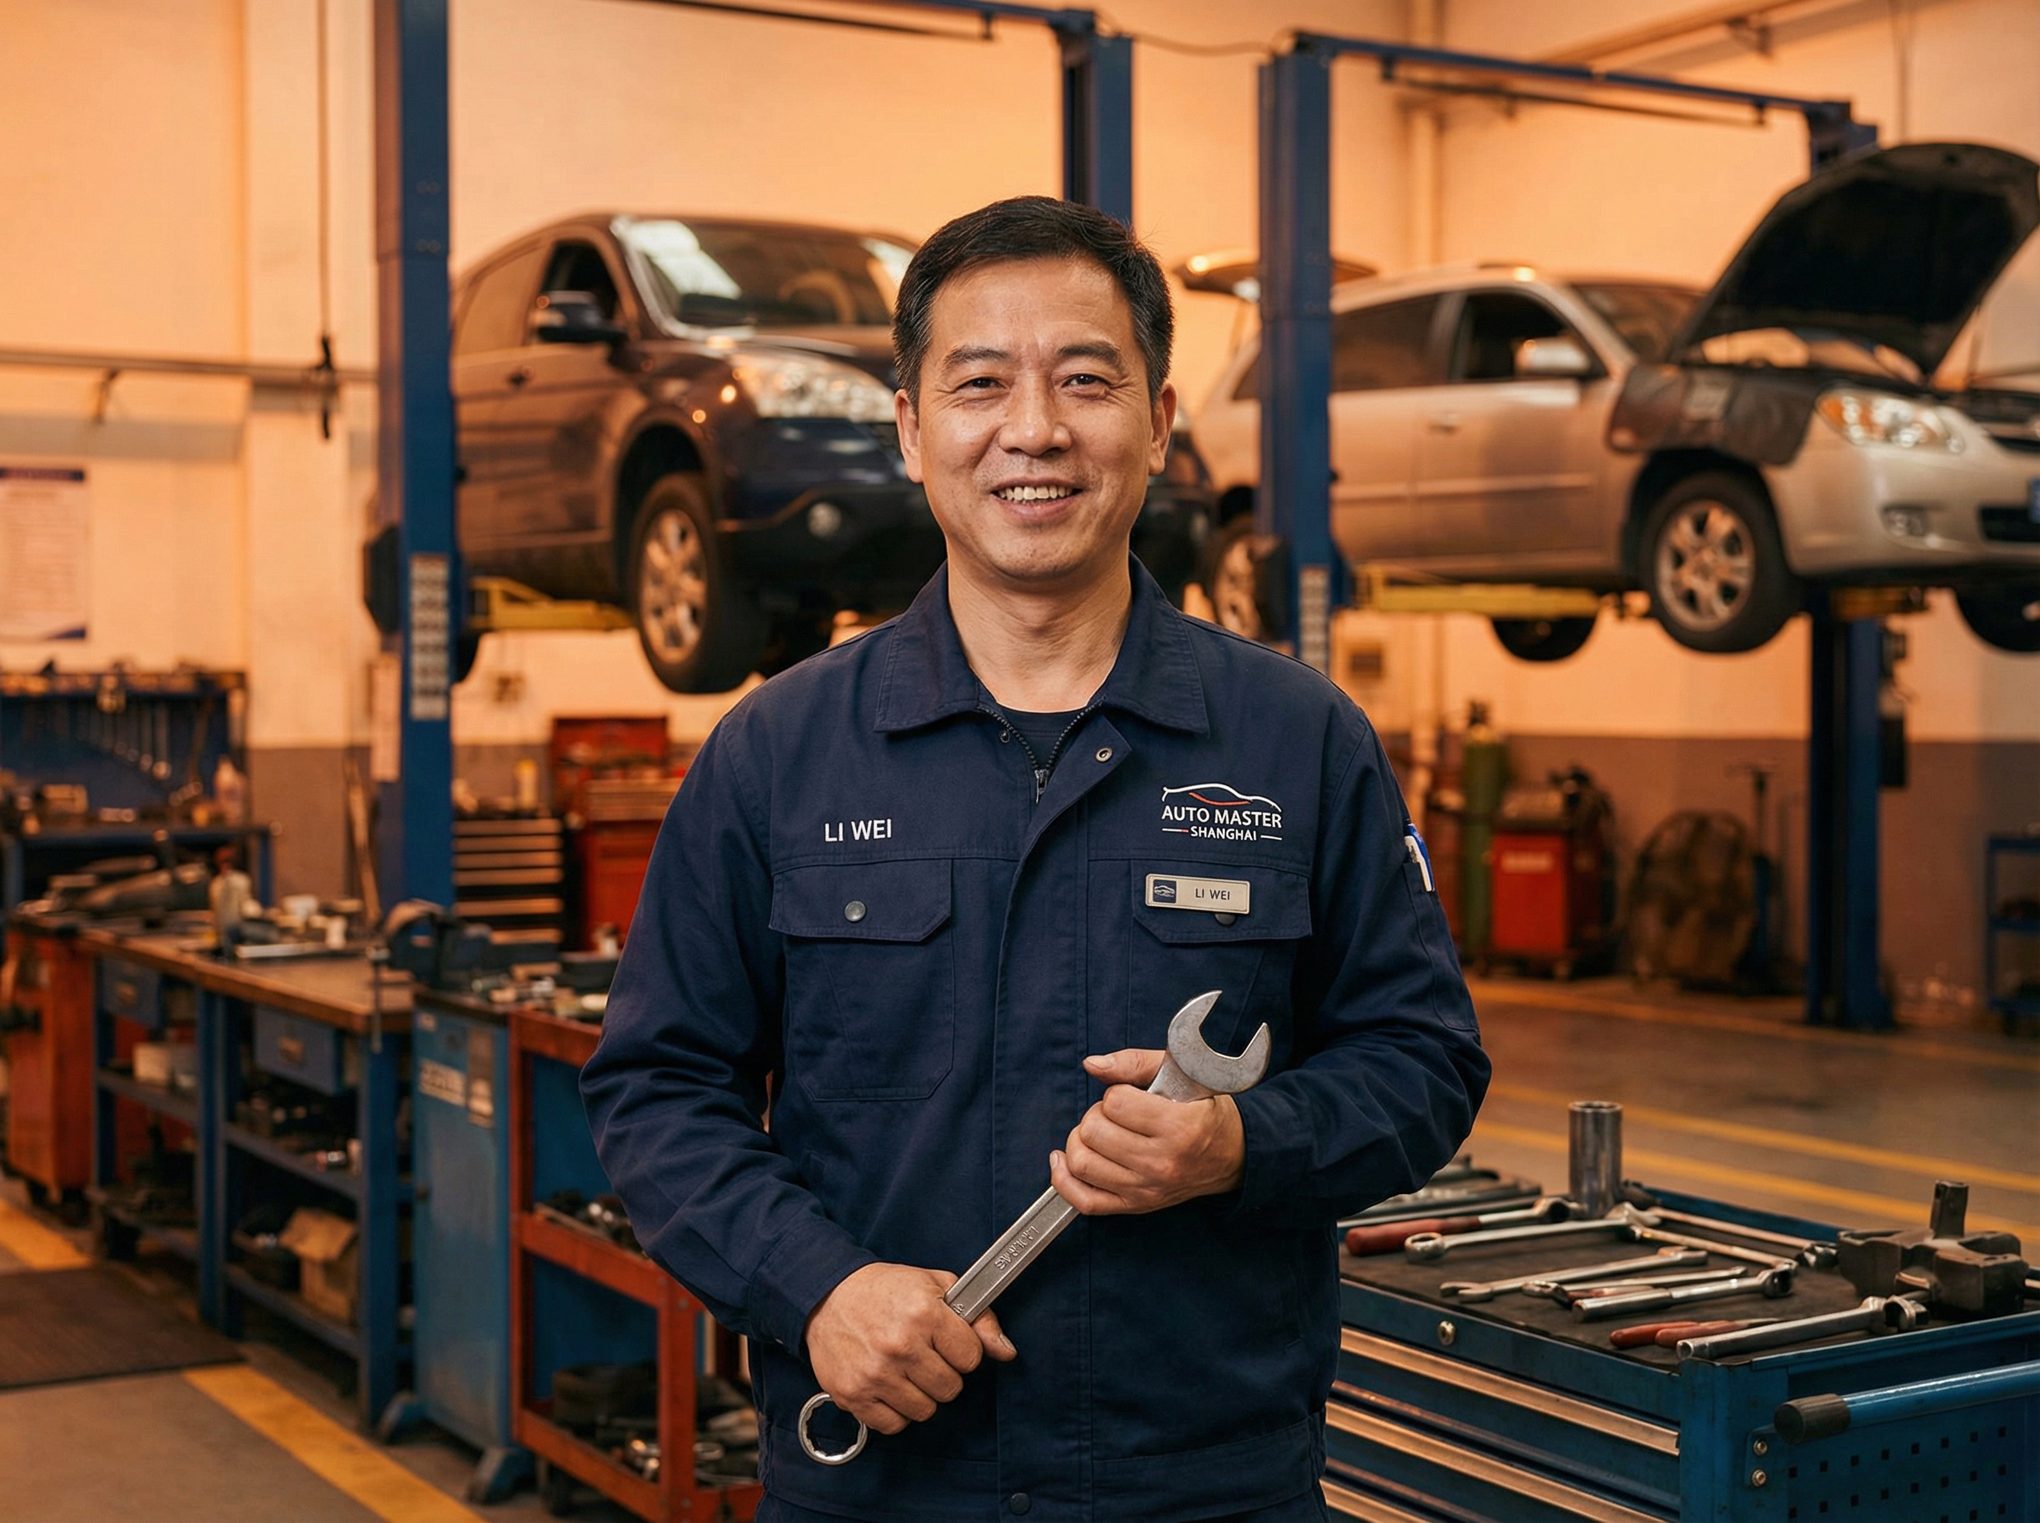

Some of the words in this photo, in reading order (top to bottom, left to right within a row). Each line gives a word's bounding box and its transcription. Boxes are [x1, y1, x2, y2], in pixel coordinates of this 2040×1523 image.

[1161, 805, 1210, 823] AUTO
[1214, 809, 1282, 828] MASTER
[824, 822, 844, 842] LI
[851, 818, 892, 841] WEI
[1190, 825, 1257, 841] SHANGHAI
[1195, 887, 1205, 899] LI
[1209, 888, 1231, 901] WEI
